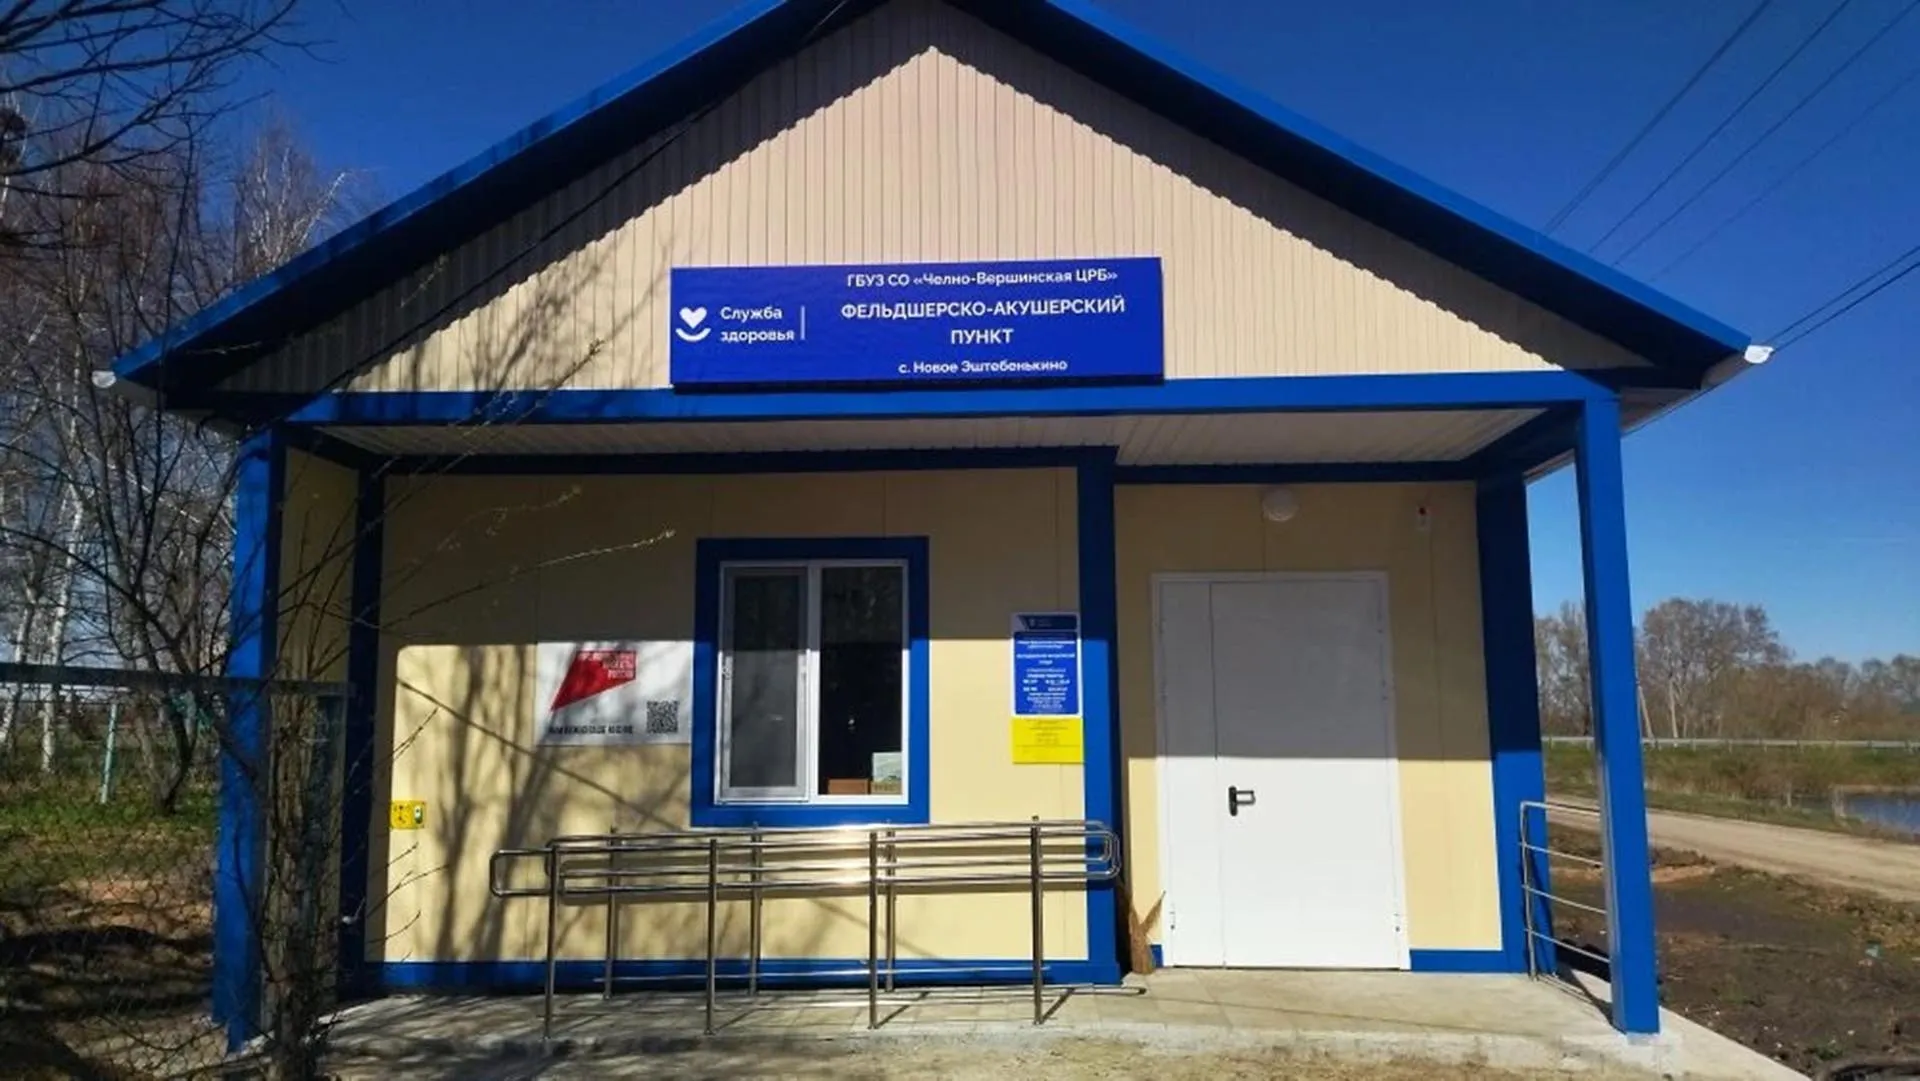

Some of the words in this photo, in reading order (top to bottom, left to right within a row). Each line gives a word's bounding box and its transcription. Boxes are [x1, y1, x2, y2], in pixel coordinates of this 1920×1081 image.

[847, 274, 884, 287] ГБУЗ
[888, 274, 910, 286] СО
[1075, 268, 1118, 283] ЦРБ»
[720, 306, 783, 324] Служба
[841, 294, 1126, 320] ФЕЛЬДШЕРСКО-АКУШЕРСКИЙ
[720, 328, 795, 345] здоровья
[950, 328, 1015, 345] ПУНКТ
[898, 362, 911, 374] с.
[913, 361, 958, 374] Новое
